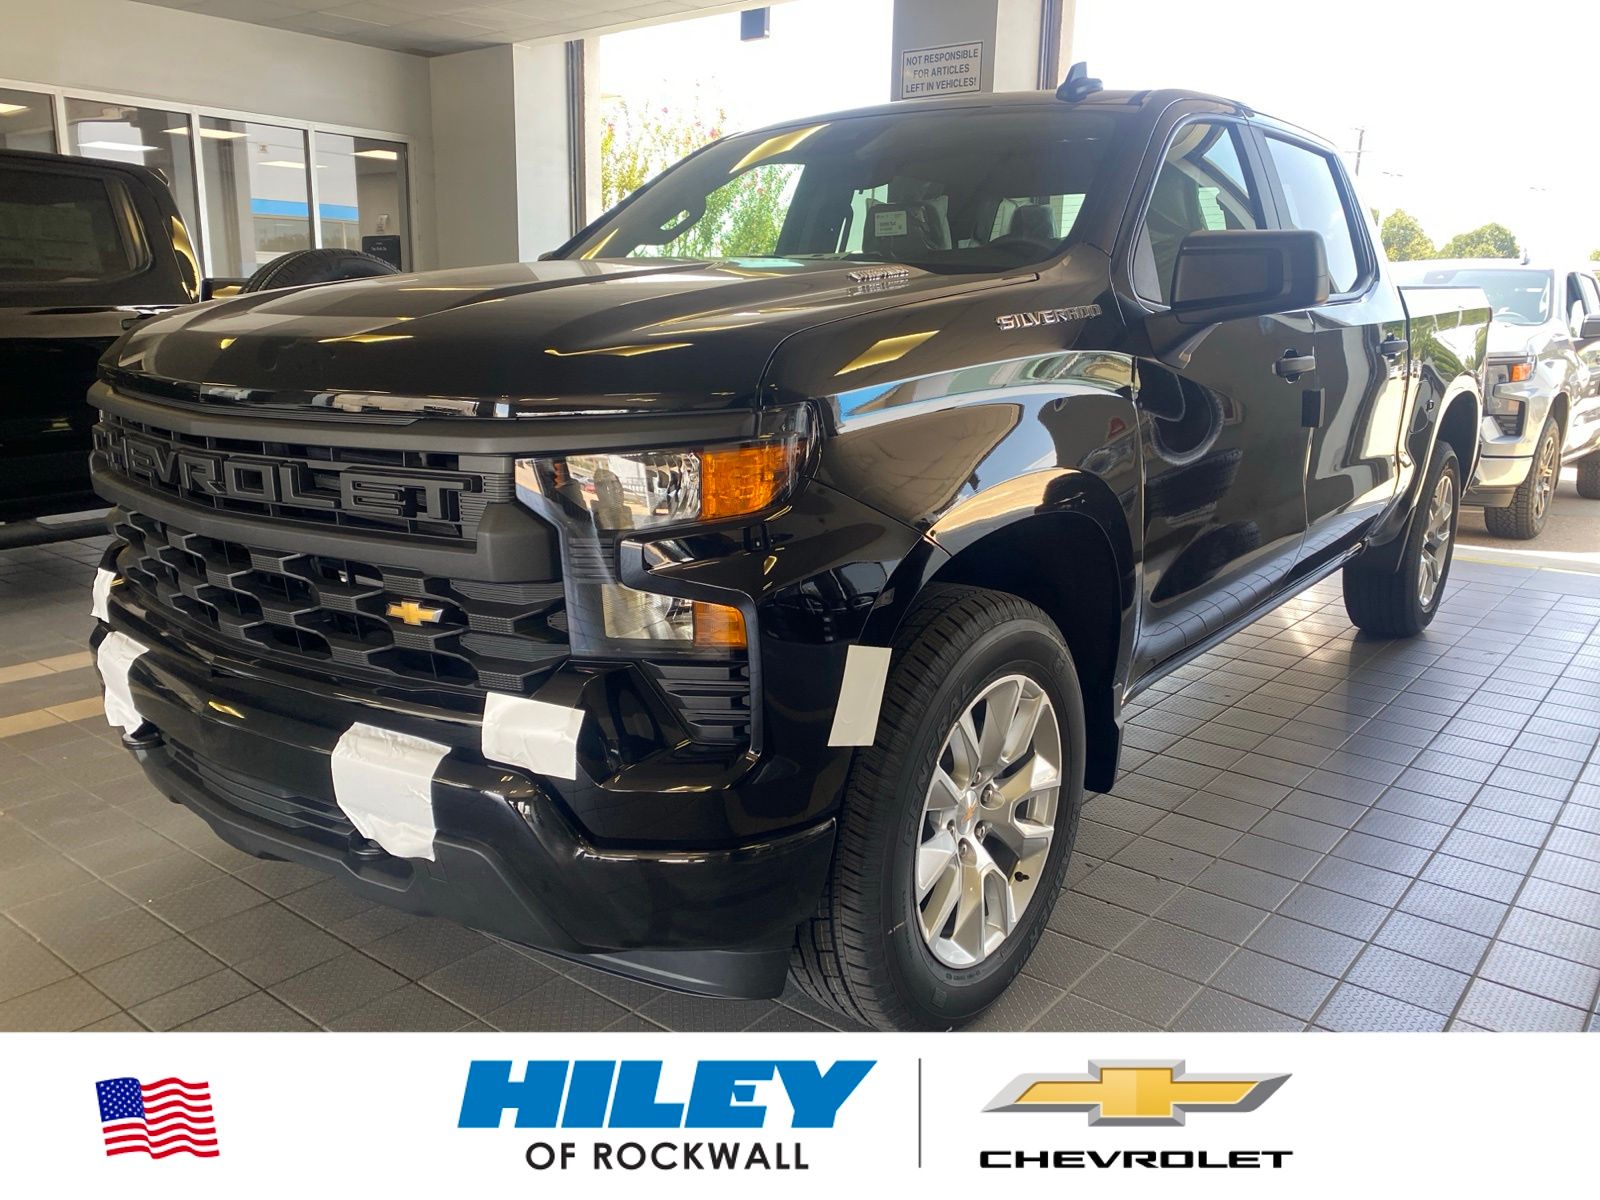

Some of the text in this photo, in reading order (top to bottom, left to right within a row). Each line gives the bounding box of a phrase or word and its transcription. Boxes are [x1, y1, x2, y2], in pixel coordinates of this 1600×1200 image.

[906, 48, 979, 66] NOT RESPONSIBLE
[913, 63, 970, 79] FOR ARTICLES
[906, 77, 977, 94] LEFT IN VEHICLES!
[996, 304, 1102, 331] SILVERADO
[902, 680, 976, 848] GENERAL
